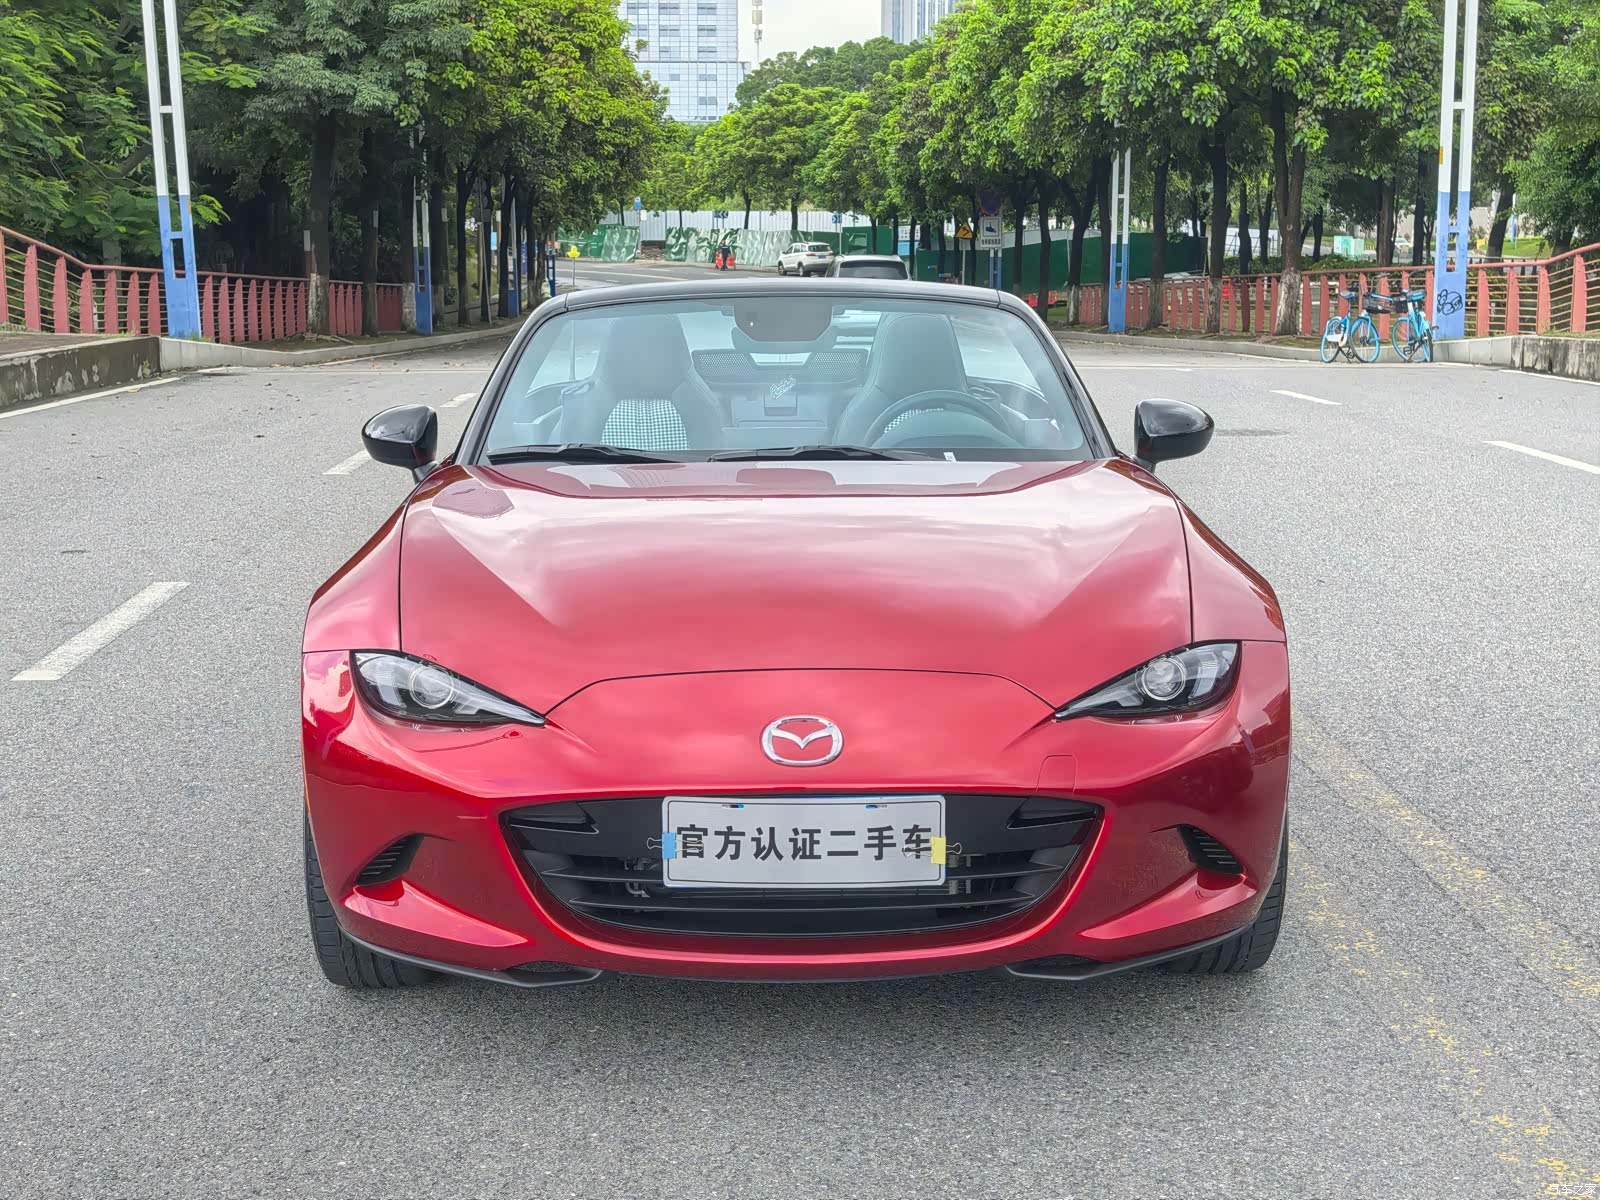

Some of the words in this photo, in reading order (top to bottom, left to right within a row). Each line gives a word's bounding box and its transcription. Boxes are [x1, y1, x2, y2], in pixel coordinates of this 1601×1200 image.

[676, 824, 932, 861] 官方认证二手车
